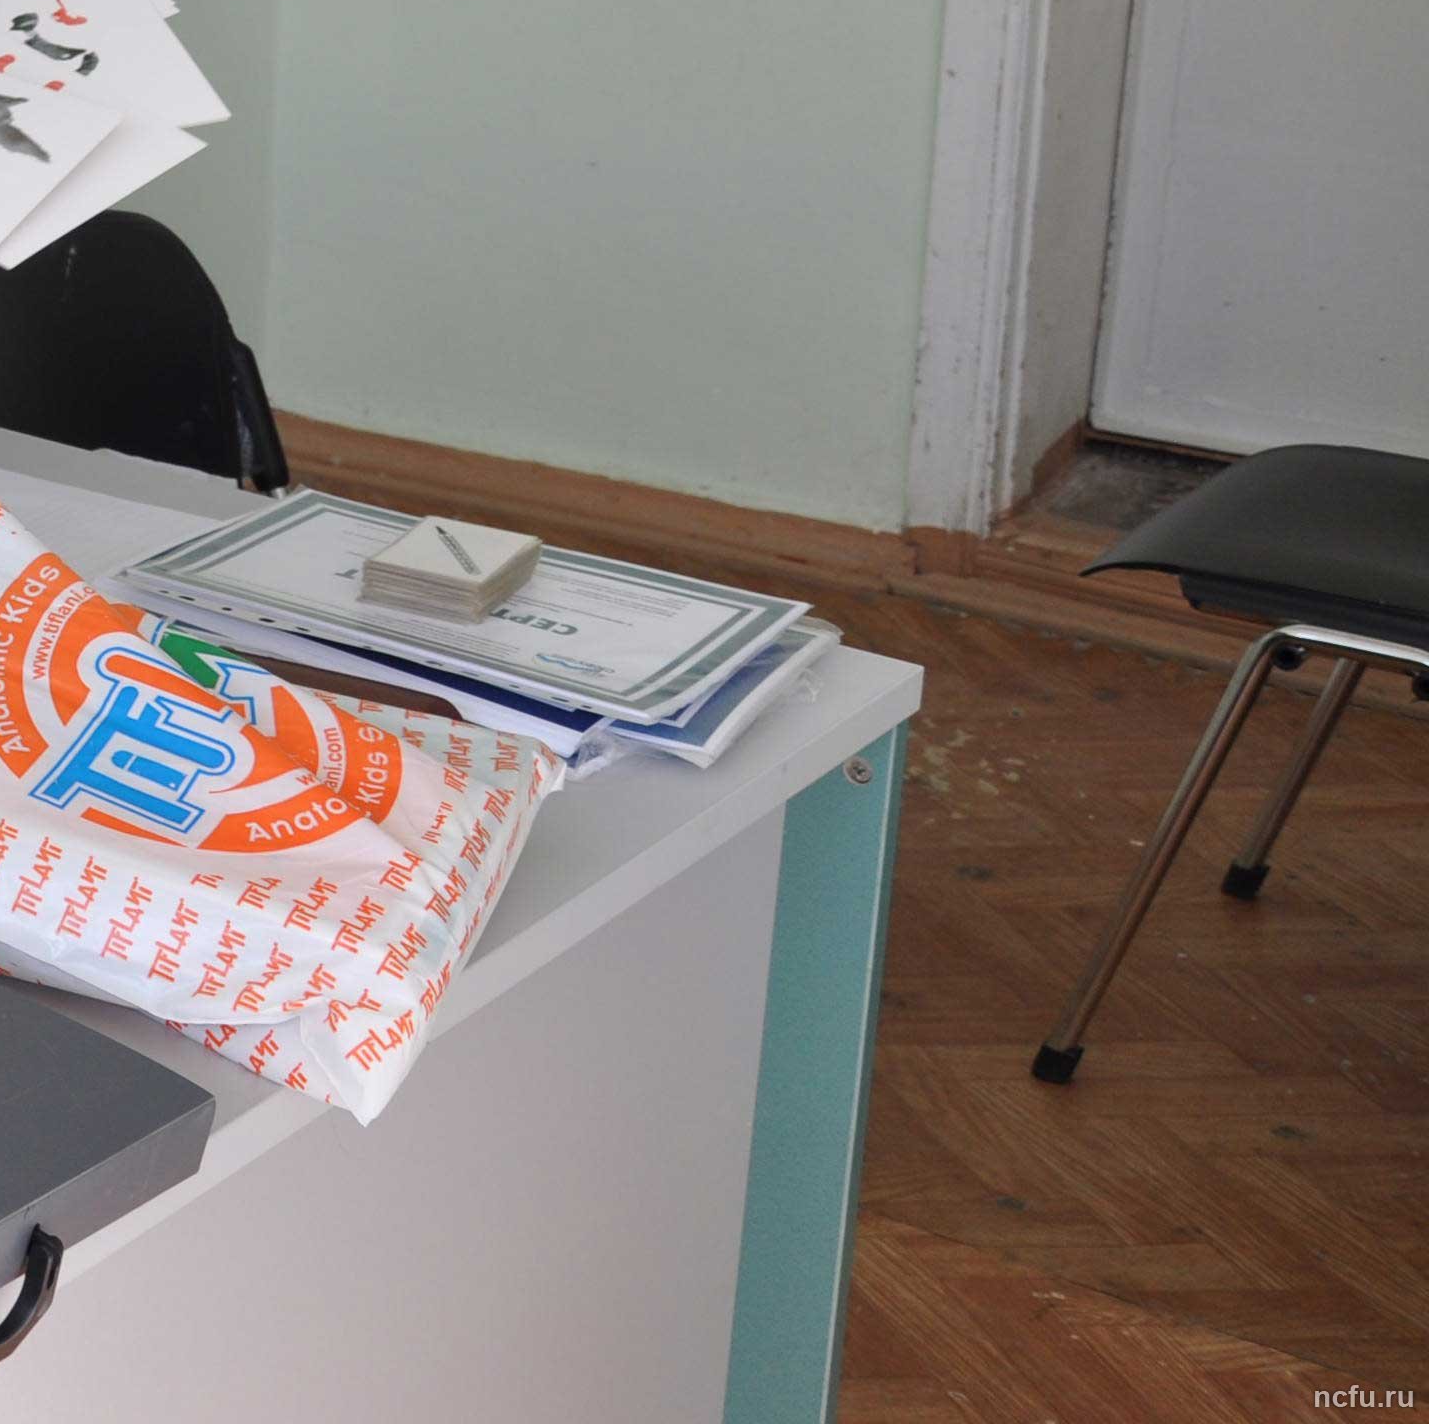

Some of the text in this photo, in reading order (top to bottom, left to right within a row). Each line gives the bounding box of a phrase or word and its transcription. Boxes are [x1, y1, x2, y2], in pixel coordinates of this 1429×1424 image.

[0, 564, 61, 624] Kids
[245, 796, 349, 843] Anato
[354, 750, 389, 806] Kids
